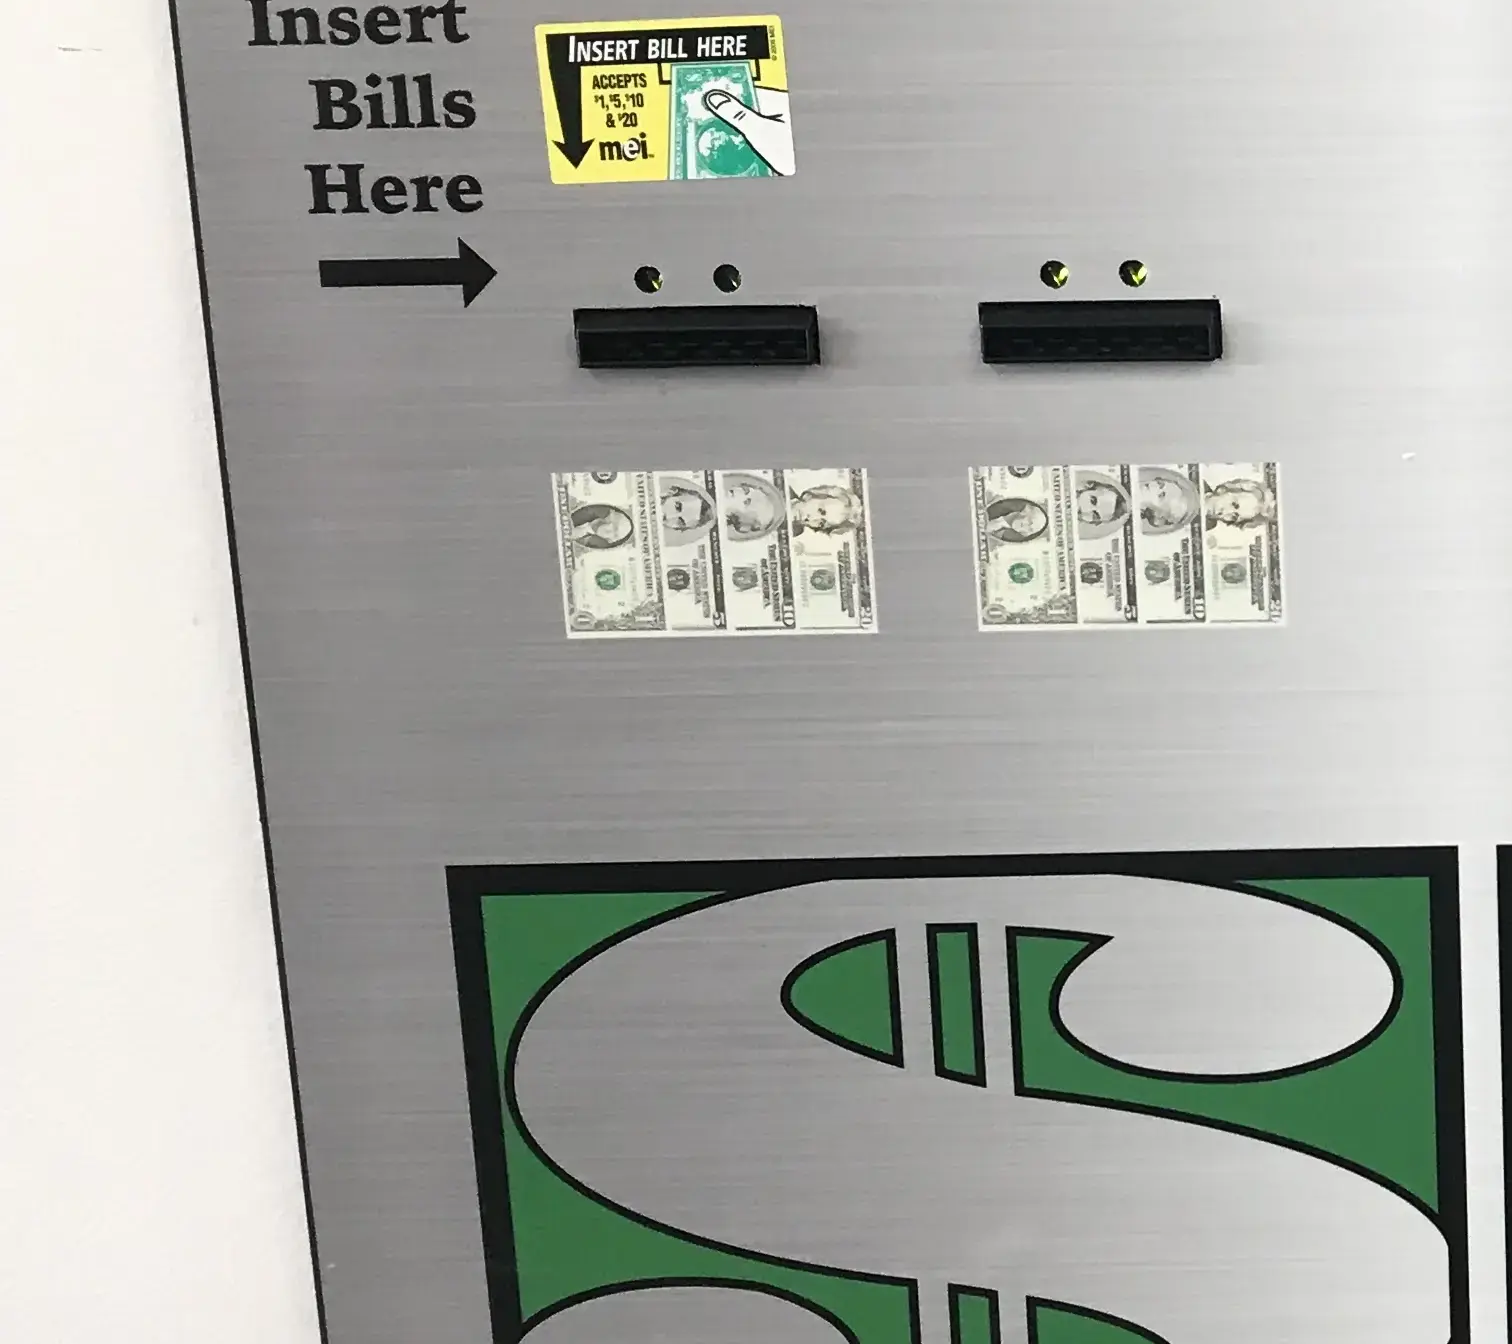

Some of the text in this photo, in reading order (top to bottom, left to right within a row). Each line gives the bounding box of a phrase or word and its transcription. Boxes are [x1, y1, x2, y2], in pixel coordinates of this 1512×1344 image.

[568, 35, 747, 63] INSERT BILL HERE
[592, 72, 648, 90] ACCEPTS
[308, 72, 477, 130] Bills
[605, 113, 616, 128] &
[304, 163, 484, 214] Here
